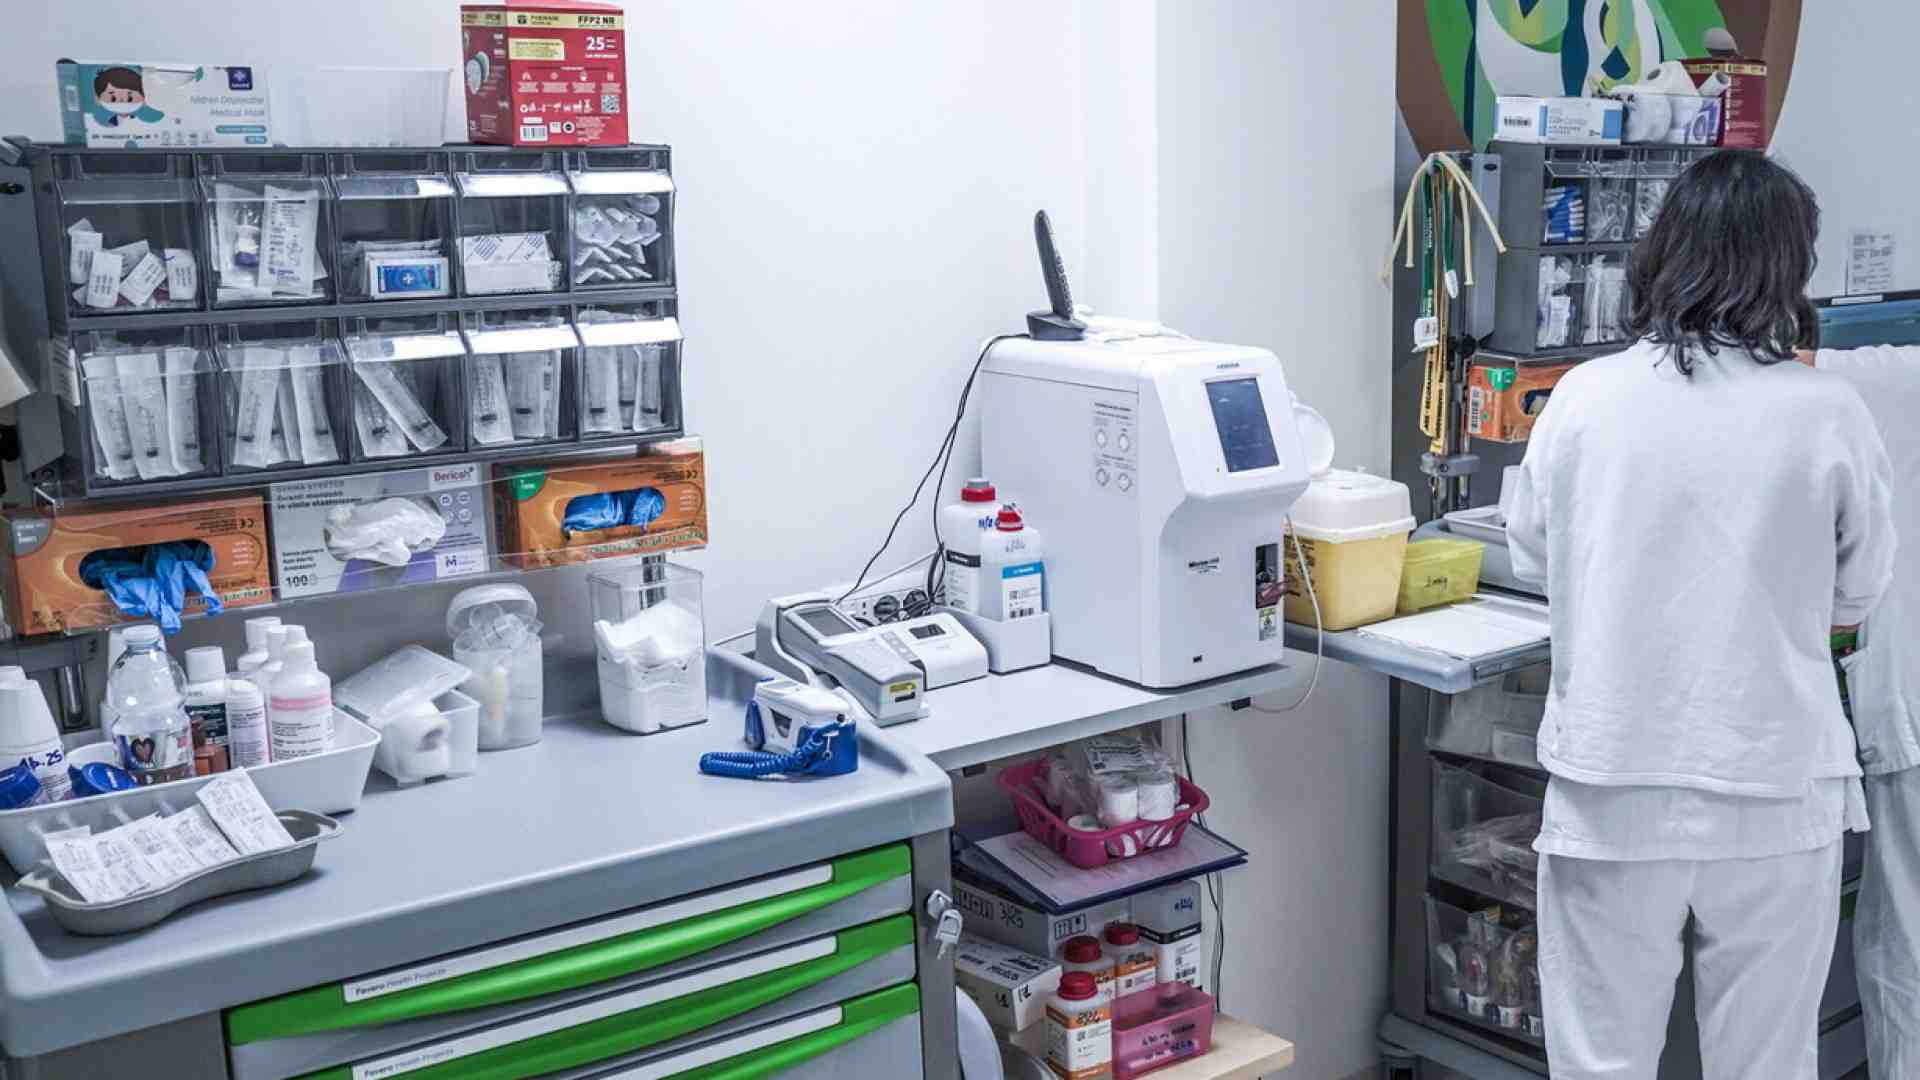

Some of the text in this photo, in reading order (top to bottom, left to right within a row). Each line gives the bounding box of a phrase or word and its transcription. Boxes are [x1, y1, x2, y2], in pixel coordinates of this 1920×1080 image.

[577, 15, 616, 25] FFP2 NR
[585, 36, 605, 51] 25
[285, 574, 308, 587] 100
